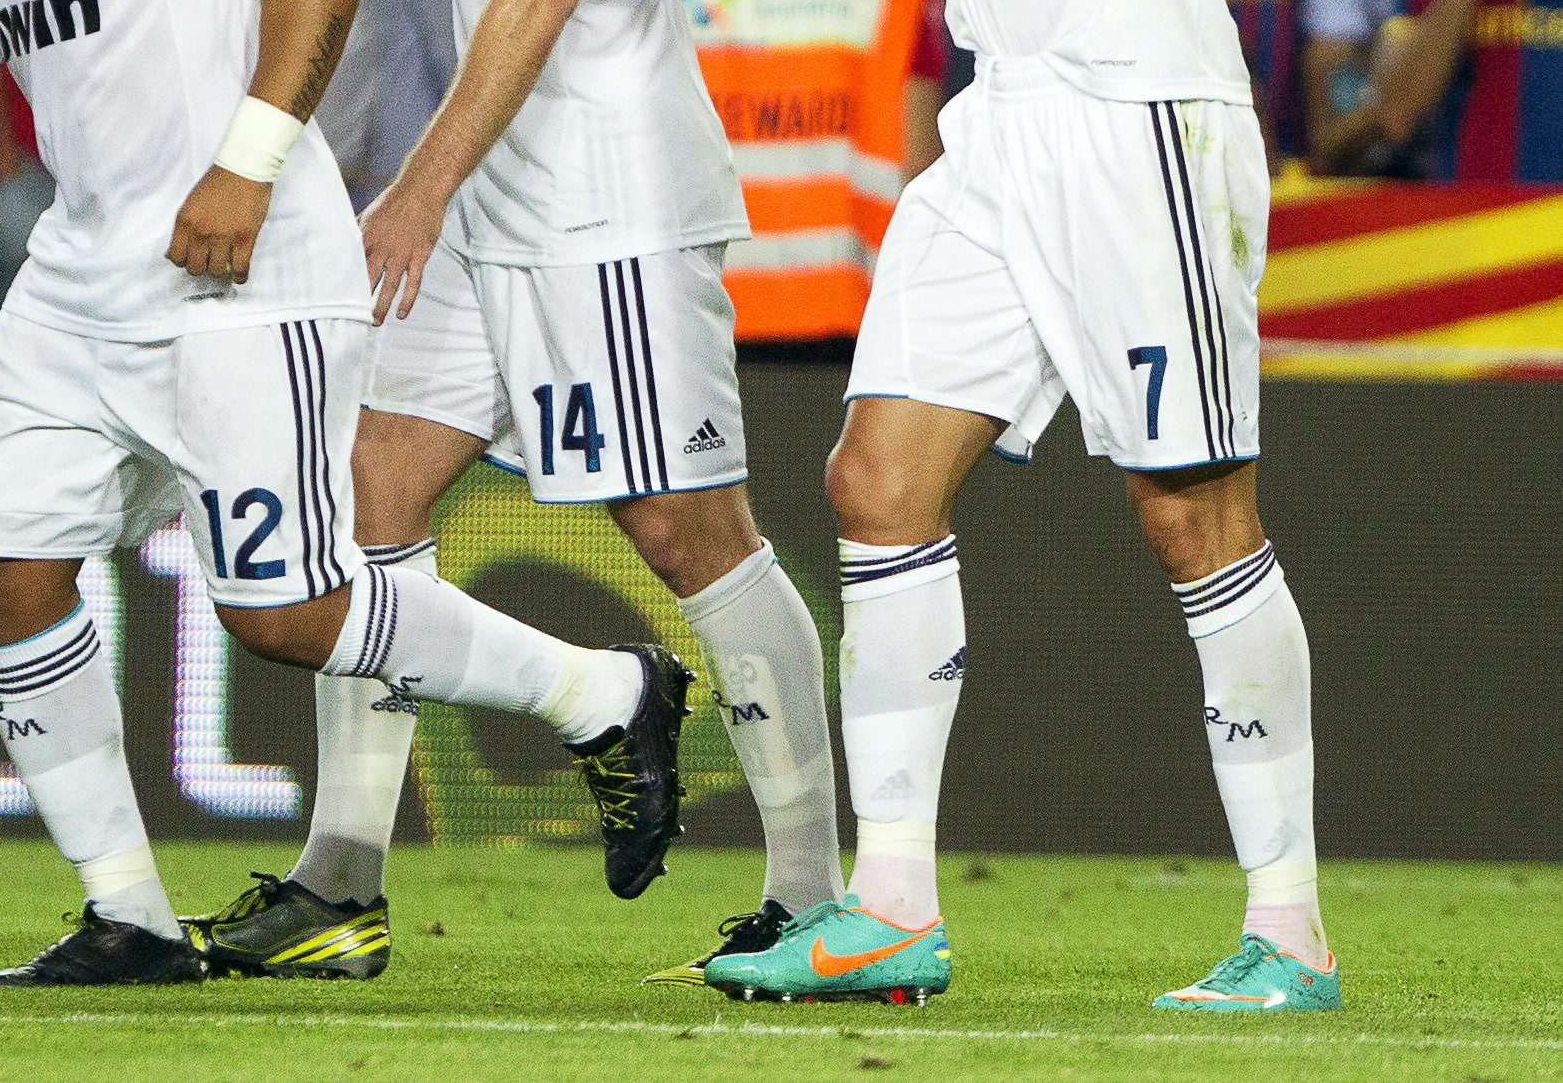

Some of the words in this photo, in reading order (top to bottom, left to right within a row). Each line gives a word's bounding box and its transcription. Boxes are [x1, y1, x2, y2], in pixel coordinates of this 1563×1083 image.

[713, 93, 851, 138] EWARD
[1127, 346, 1167, 440] 7
[532, 382, 605, 475] 14
[684, 436, 726, 454] adidas
[200, 487, 286, 580] 12
[1203, 706, 1268, 742] RM
